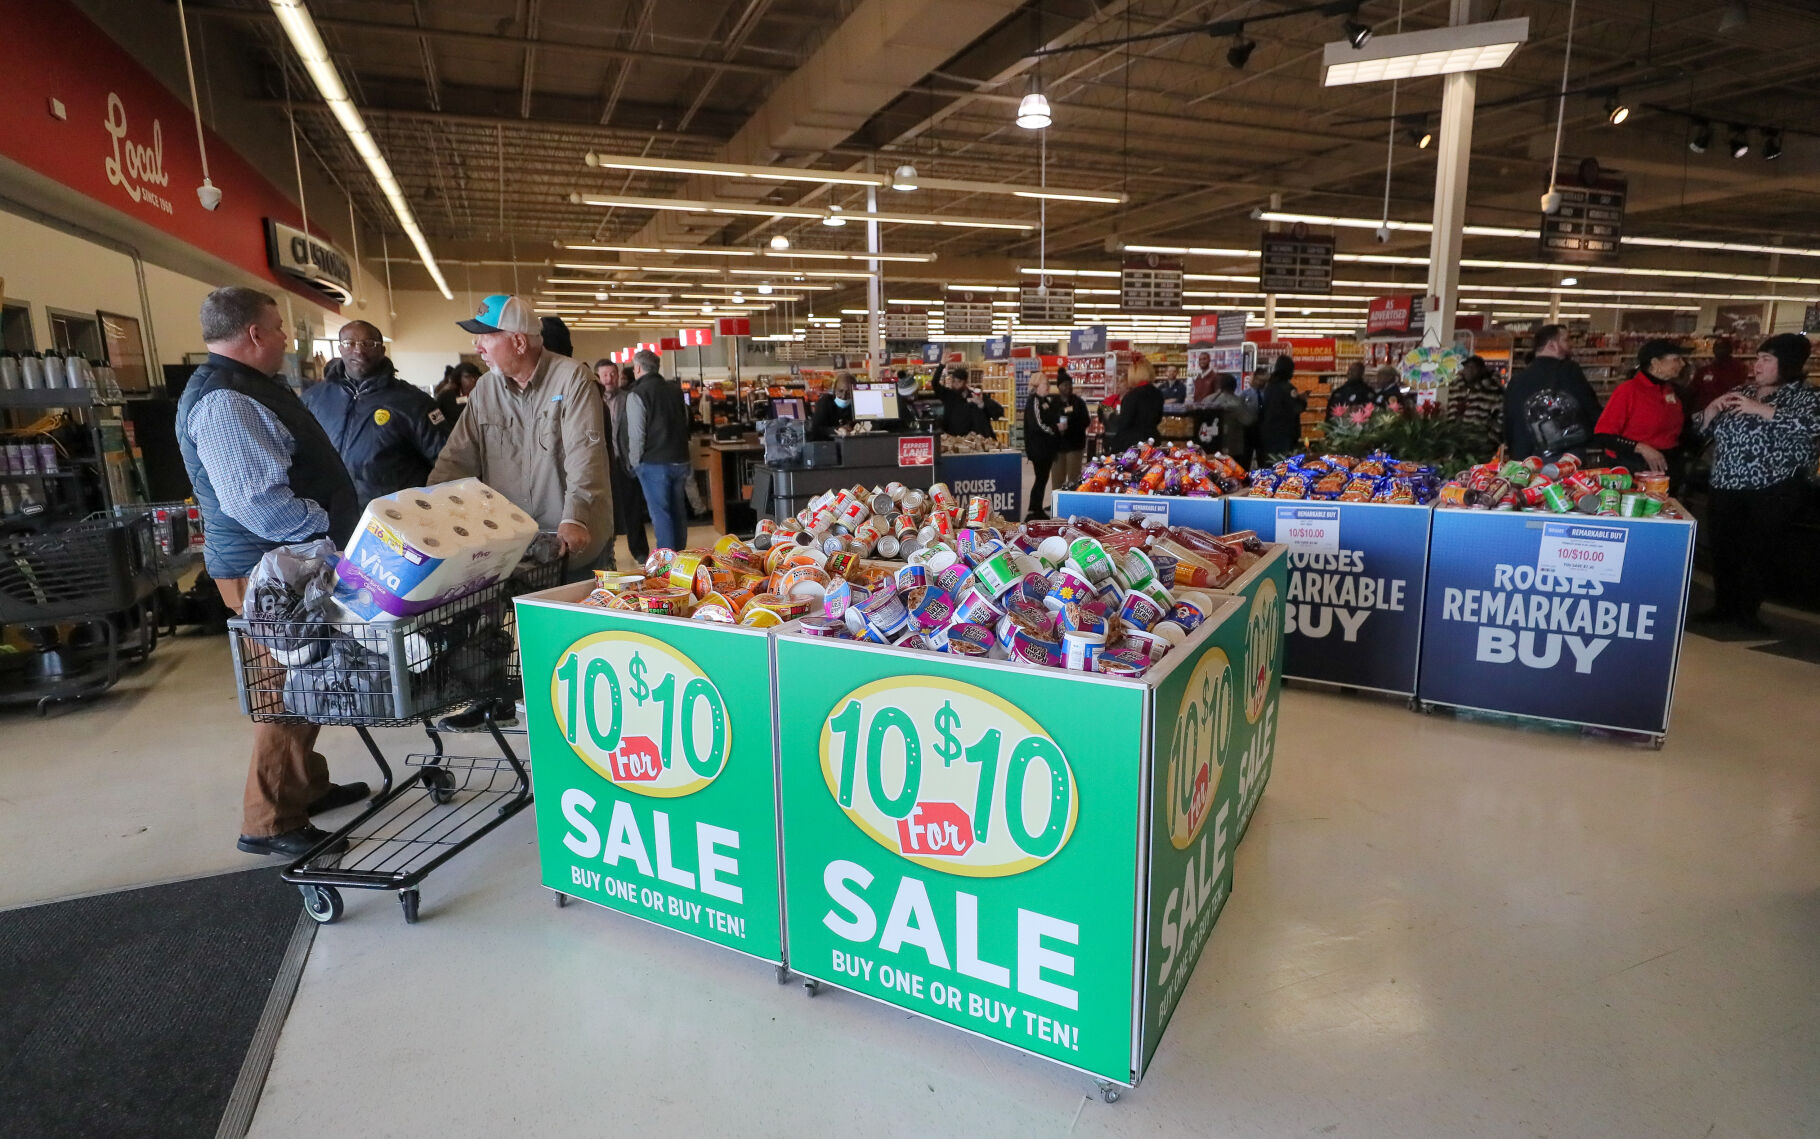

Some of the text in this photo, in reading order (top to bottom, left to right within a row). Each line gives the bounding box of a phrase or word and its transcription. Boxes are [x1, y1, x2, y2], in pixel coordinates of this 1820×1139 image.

[104, 92, 168, 203] Local
[141, 187, 159, 208] SINCE
[1385, 299, 1394, 309] AS
[1310, 347, 1333, 355] LOCAL
[903, 448, 929, 457] LANE
[954, 480, 996, 494] ROUSES
[1289, 528, 1324, 538] 10/$10.00
[1297, 510, 1326, 518] REMARKABLE
[1571, 528, 1609, 539] REMARKABLE
[1610, 532, 1623, 540] BUY
[360, 548, 401, 591] Viva
[1558, 548, 1604, 562] 10/$10.00
[1286, 571, 1406, 612] ARKABLE
[1494, 563, 1605, 596] ROUSES
[1134, 601, 1154, 618] Raisin
[1134, 607, 1149, 622] Bran
[1284, 603, 1372, 642] BUY
[1442, 587, 1658, 641] REMARKABLE
[1476, 625, 1612, 675] BUY
[556, 652, 623, 753] 10
[616, 741, 657, 778] For
[1171, 700, 1199, 839] 10
[1201, 665, 1234, 783] $10
[1237, 699, 1275, 818] SALE
[829, 699, 922, 820] 10
[909, 806, 966, 852] For
[561, 788, 743, 905] SALE
[571, 865, 746, 939] BUY ONE OR BUY TEN!
[1159, 798, 1230, 986] SALE
[822, 859, 1079, 1011] SALE
[1158, 880, 1224, 1027] BUY ONE OR BUY TEN!
[832, 949, 1079, 1051] BUY ONE OR BUY TEN!
